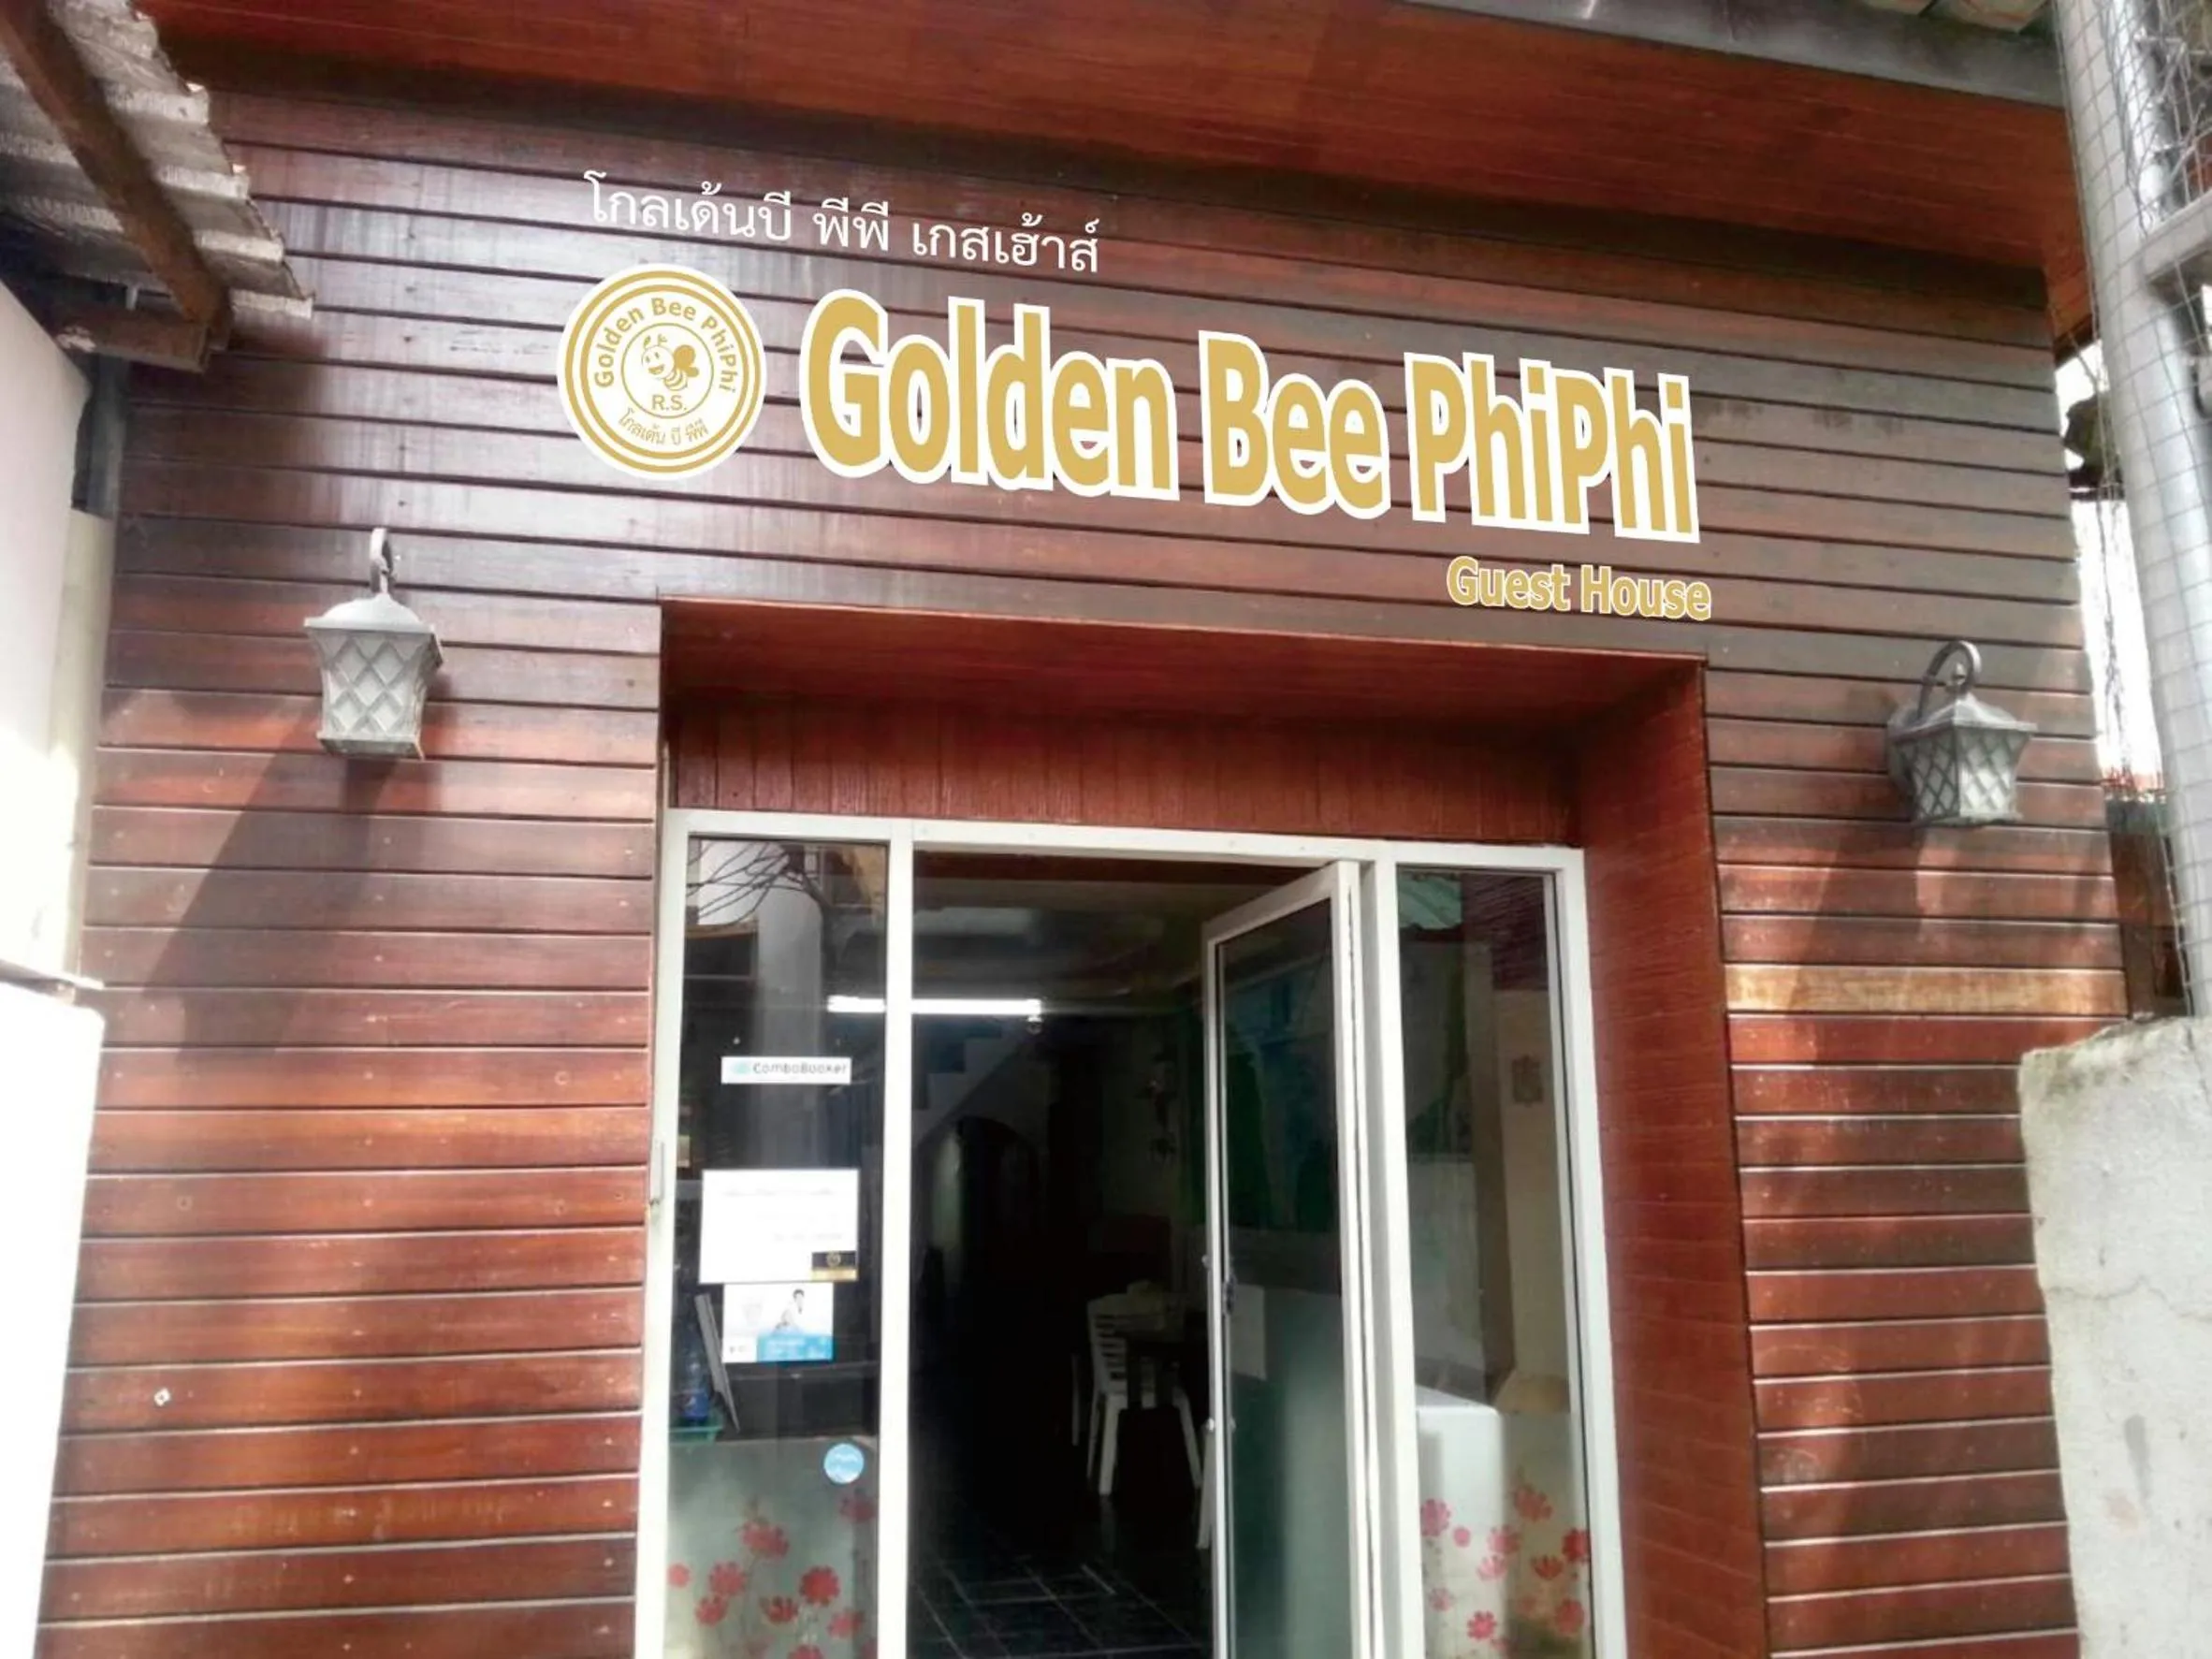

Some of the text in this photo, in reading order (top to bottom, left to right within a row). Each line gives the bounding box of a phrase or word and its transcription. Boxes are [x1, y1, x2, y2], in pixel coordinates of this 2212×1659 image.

[583, 169, 1099, 272] โกลเด้นบี พีพี เกสเฮ้าส์
[594, 297, 738, 393] Golden Bee PhiPhi
[651, 394, 688, 411] R.S.
[799, 288, 1700, 543] Golden Bee PhiPhi
[1447, 556, 1711, 621] Guest House
